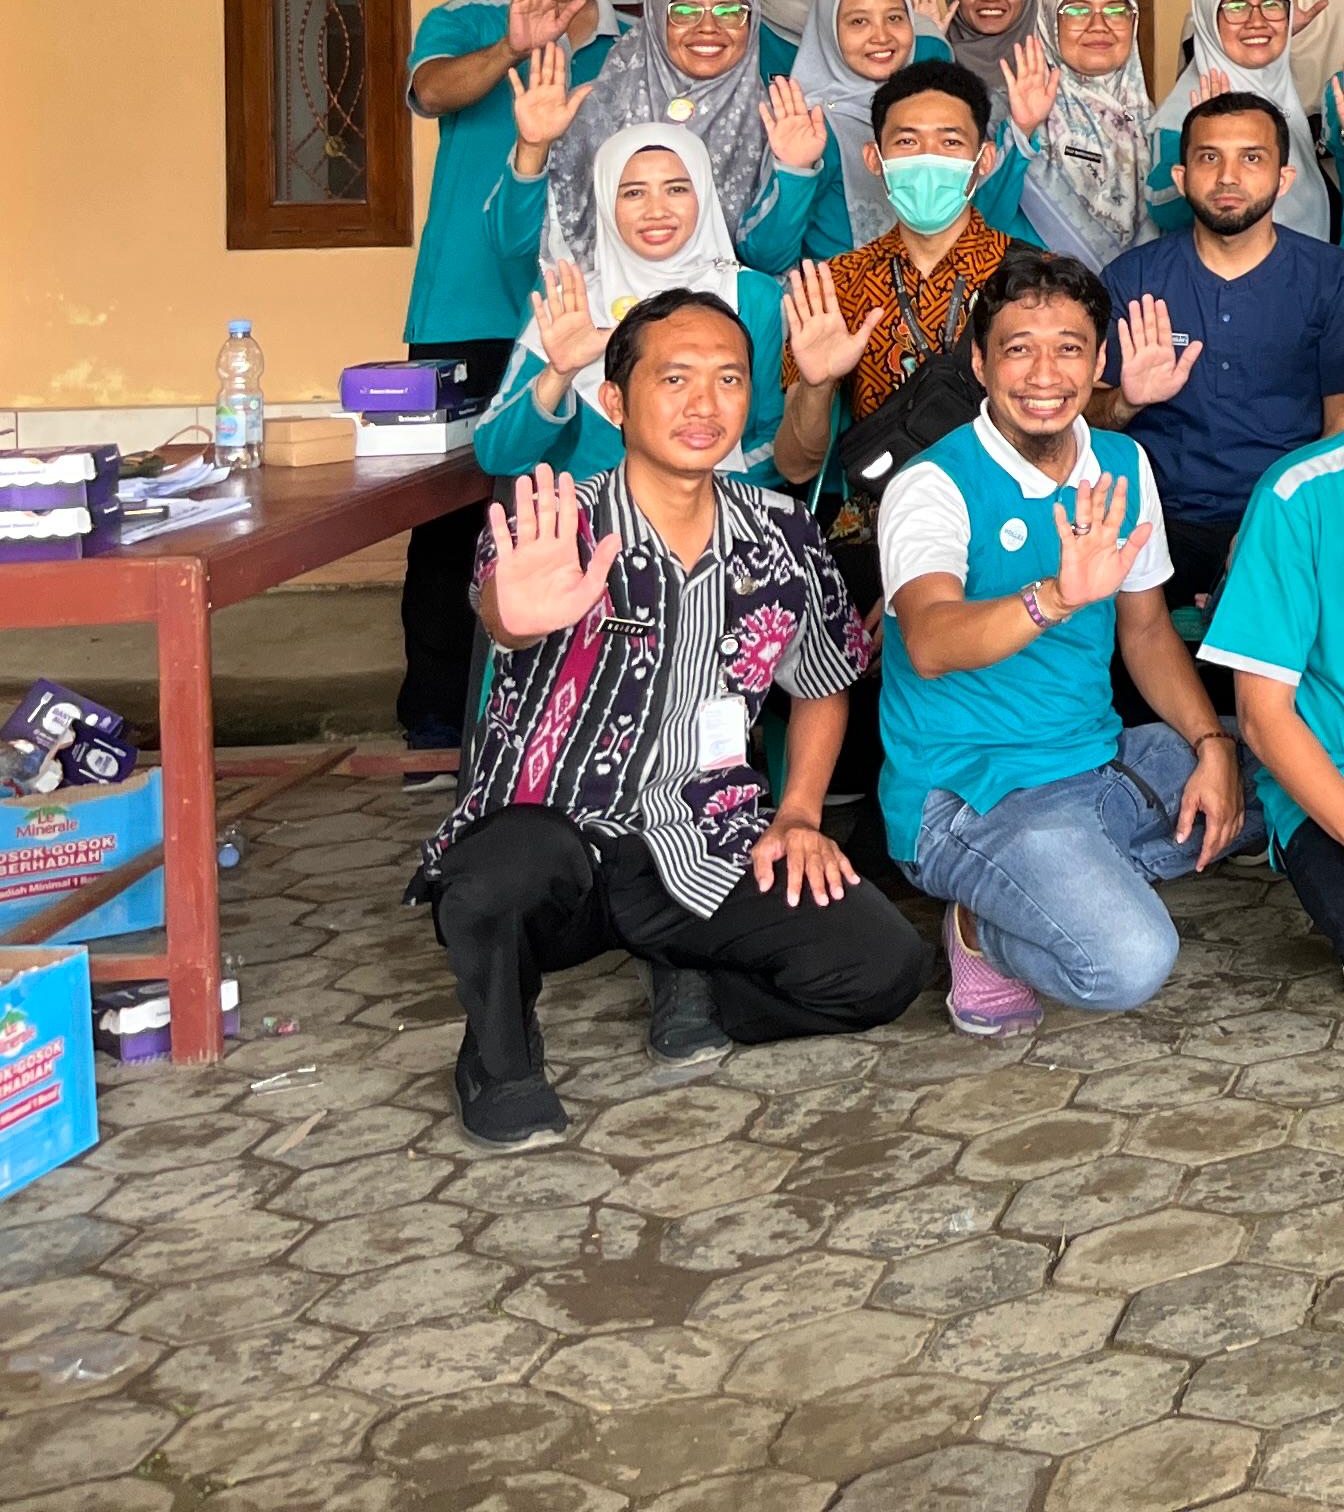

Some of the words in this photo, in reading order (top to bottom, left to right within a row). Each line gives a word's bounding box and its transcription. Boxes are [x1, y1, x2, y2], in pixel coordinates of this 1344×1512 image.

[38, 807, 55, 824] Le
[16, 819, 78, 838] Minerale
[0, 835, 115, 864] OSOK-GOSOK
